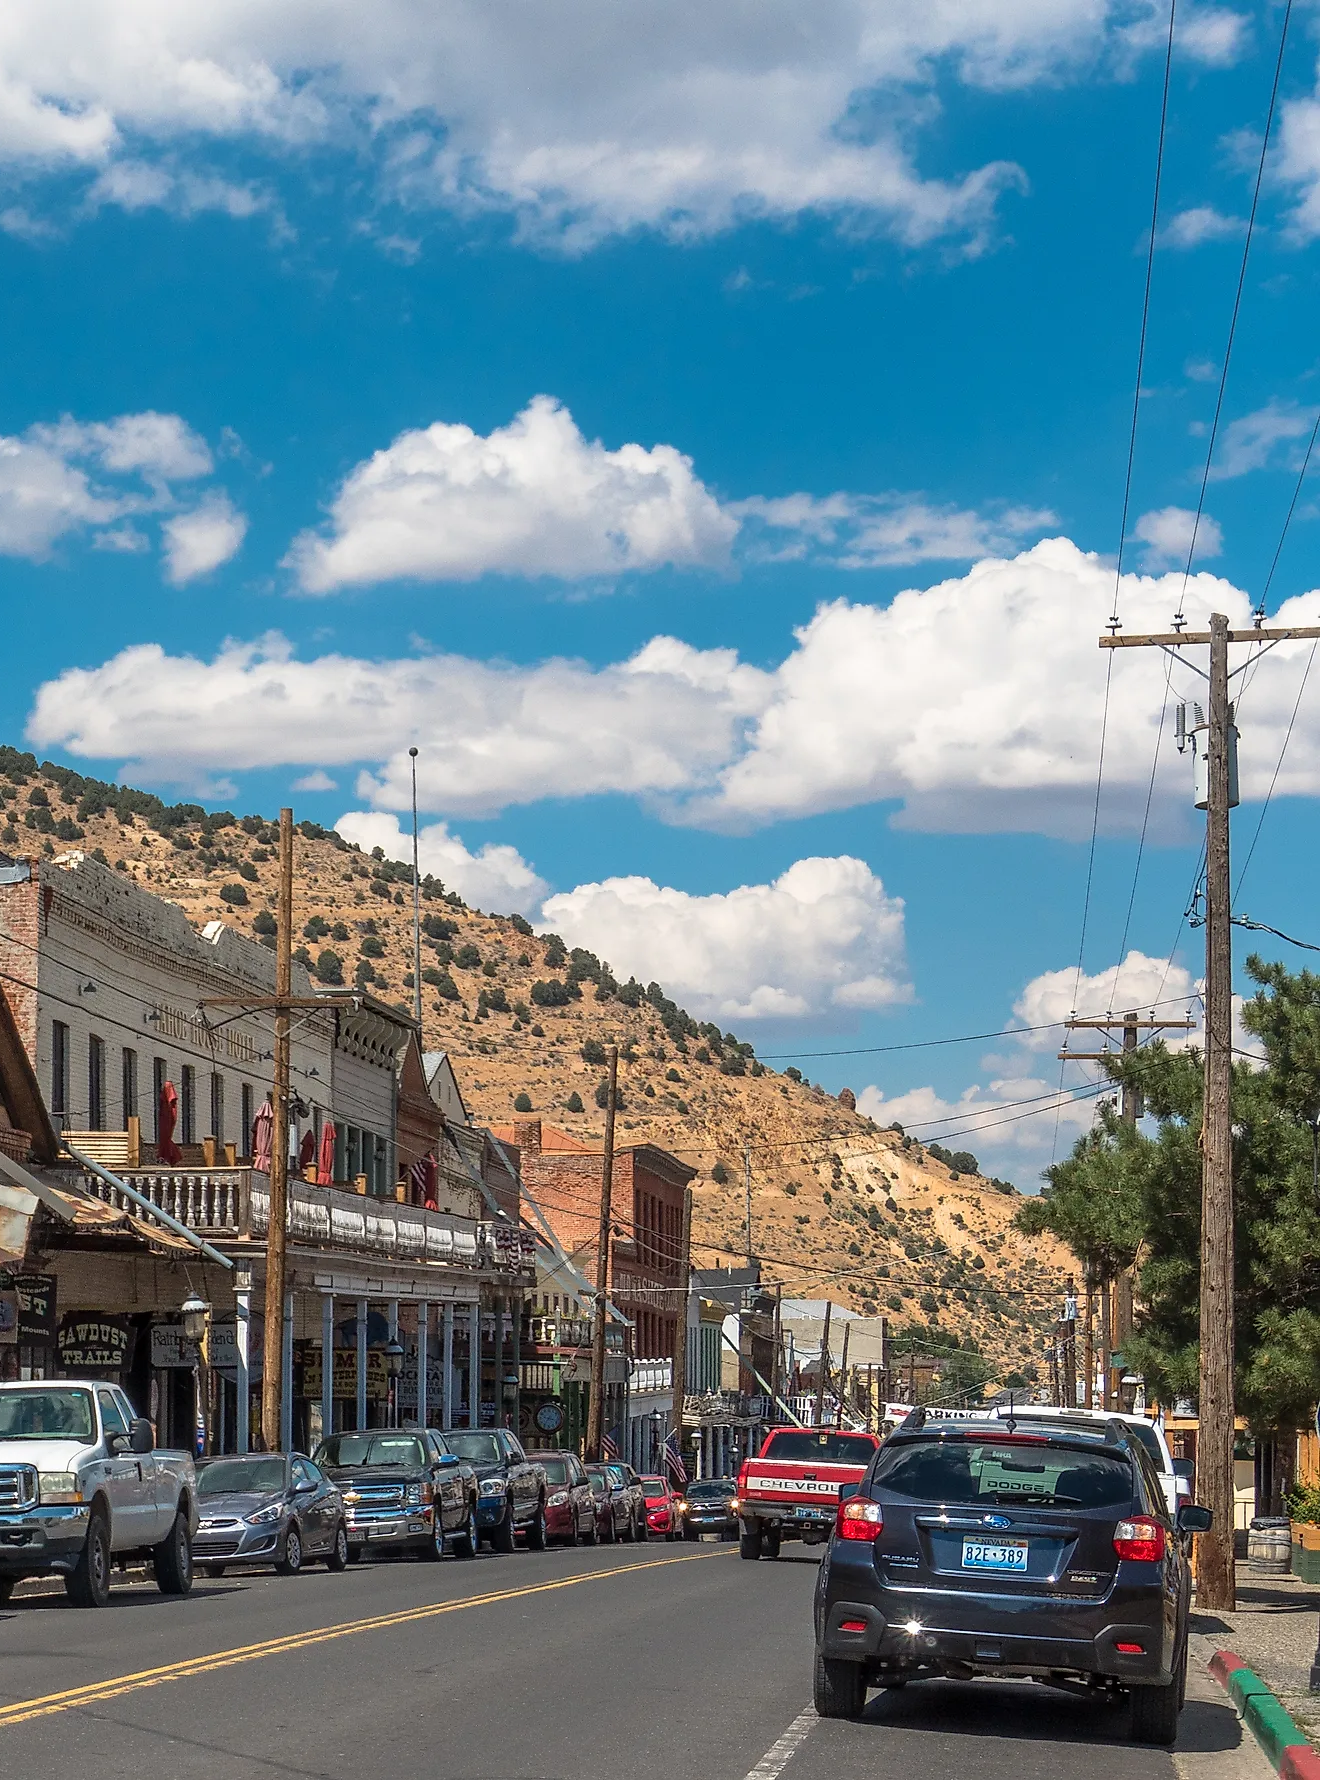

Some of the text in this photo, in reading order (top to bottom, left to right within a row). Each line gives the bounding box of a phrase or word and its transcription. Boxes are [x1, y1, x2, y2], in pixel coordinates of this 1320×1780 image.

[58, 1323, 128, 1350] SAWDUST
[62, 1350, 123, 1366] TRAILS
[924, 1409, 978, 1420] ARKING
[760, 1479, 840, 1493] CHEVROL
[987, 1480, 1045, 1493] DODGE
[981, 1538, 1011, 1547] NEVADA
